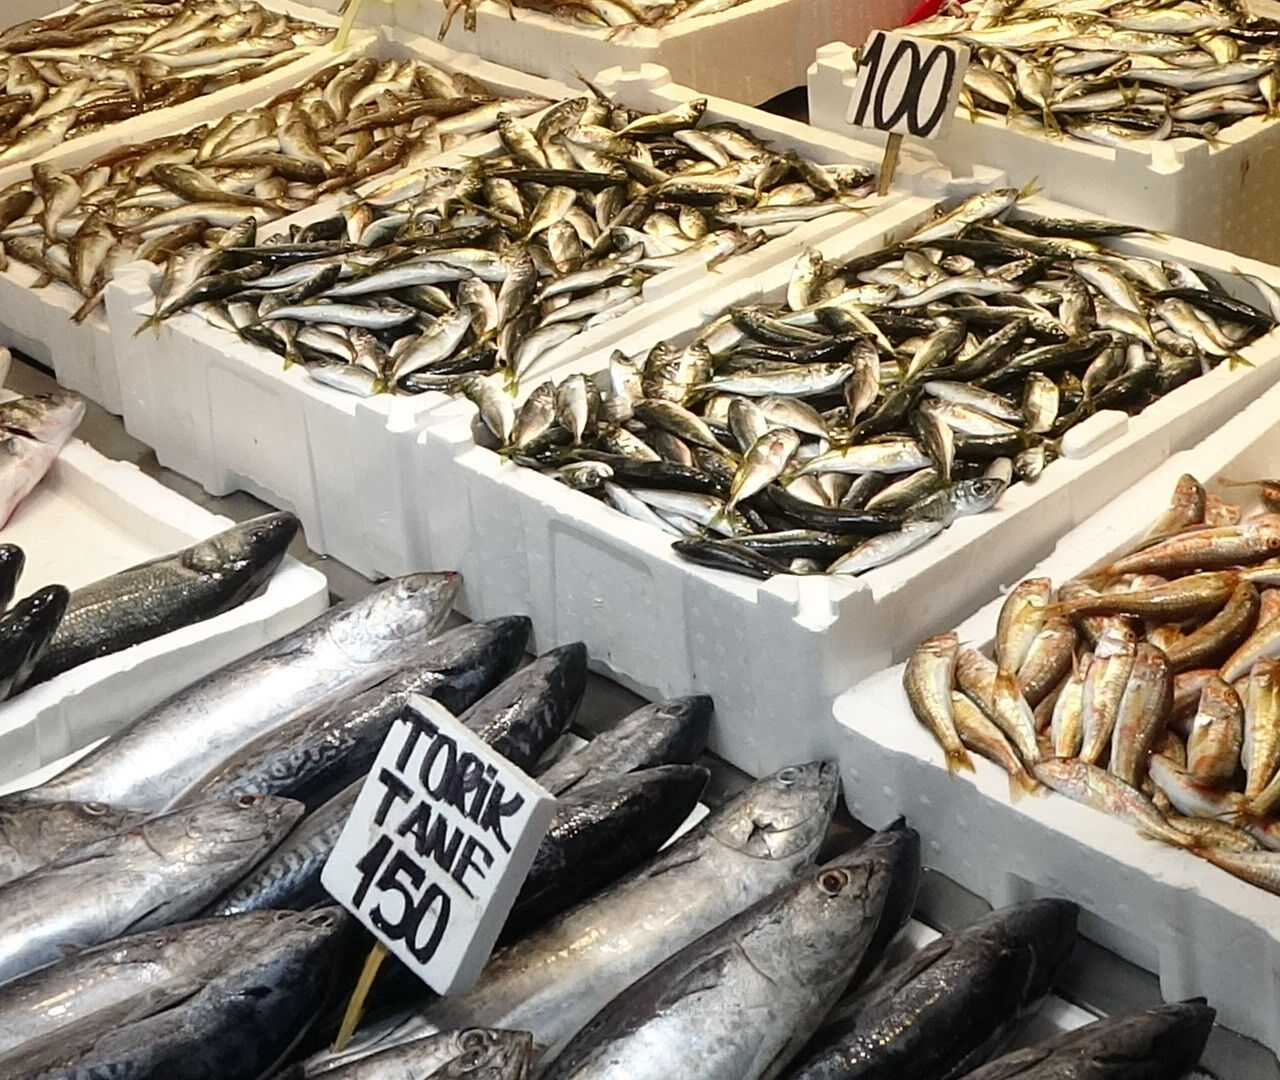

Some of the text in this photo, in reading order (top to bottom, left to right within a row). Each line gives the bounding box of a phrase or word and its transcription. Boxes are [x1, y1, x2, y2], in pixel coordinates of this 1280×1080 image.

[853, 31, 956, 138] 100
[352, 834, 452, 966] 150
[374, 767, 495, 901] TANE
